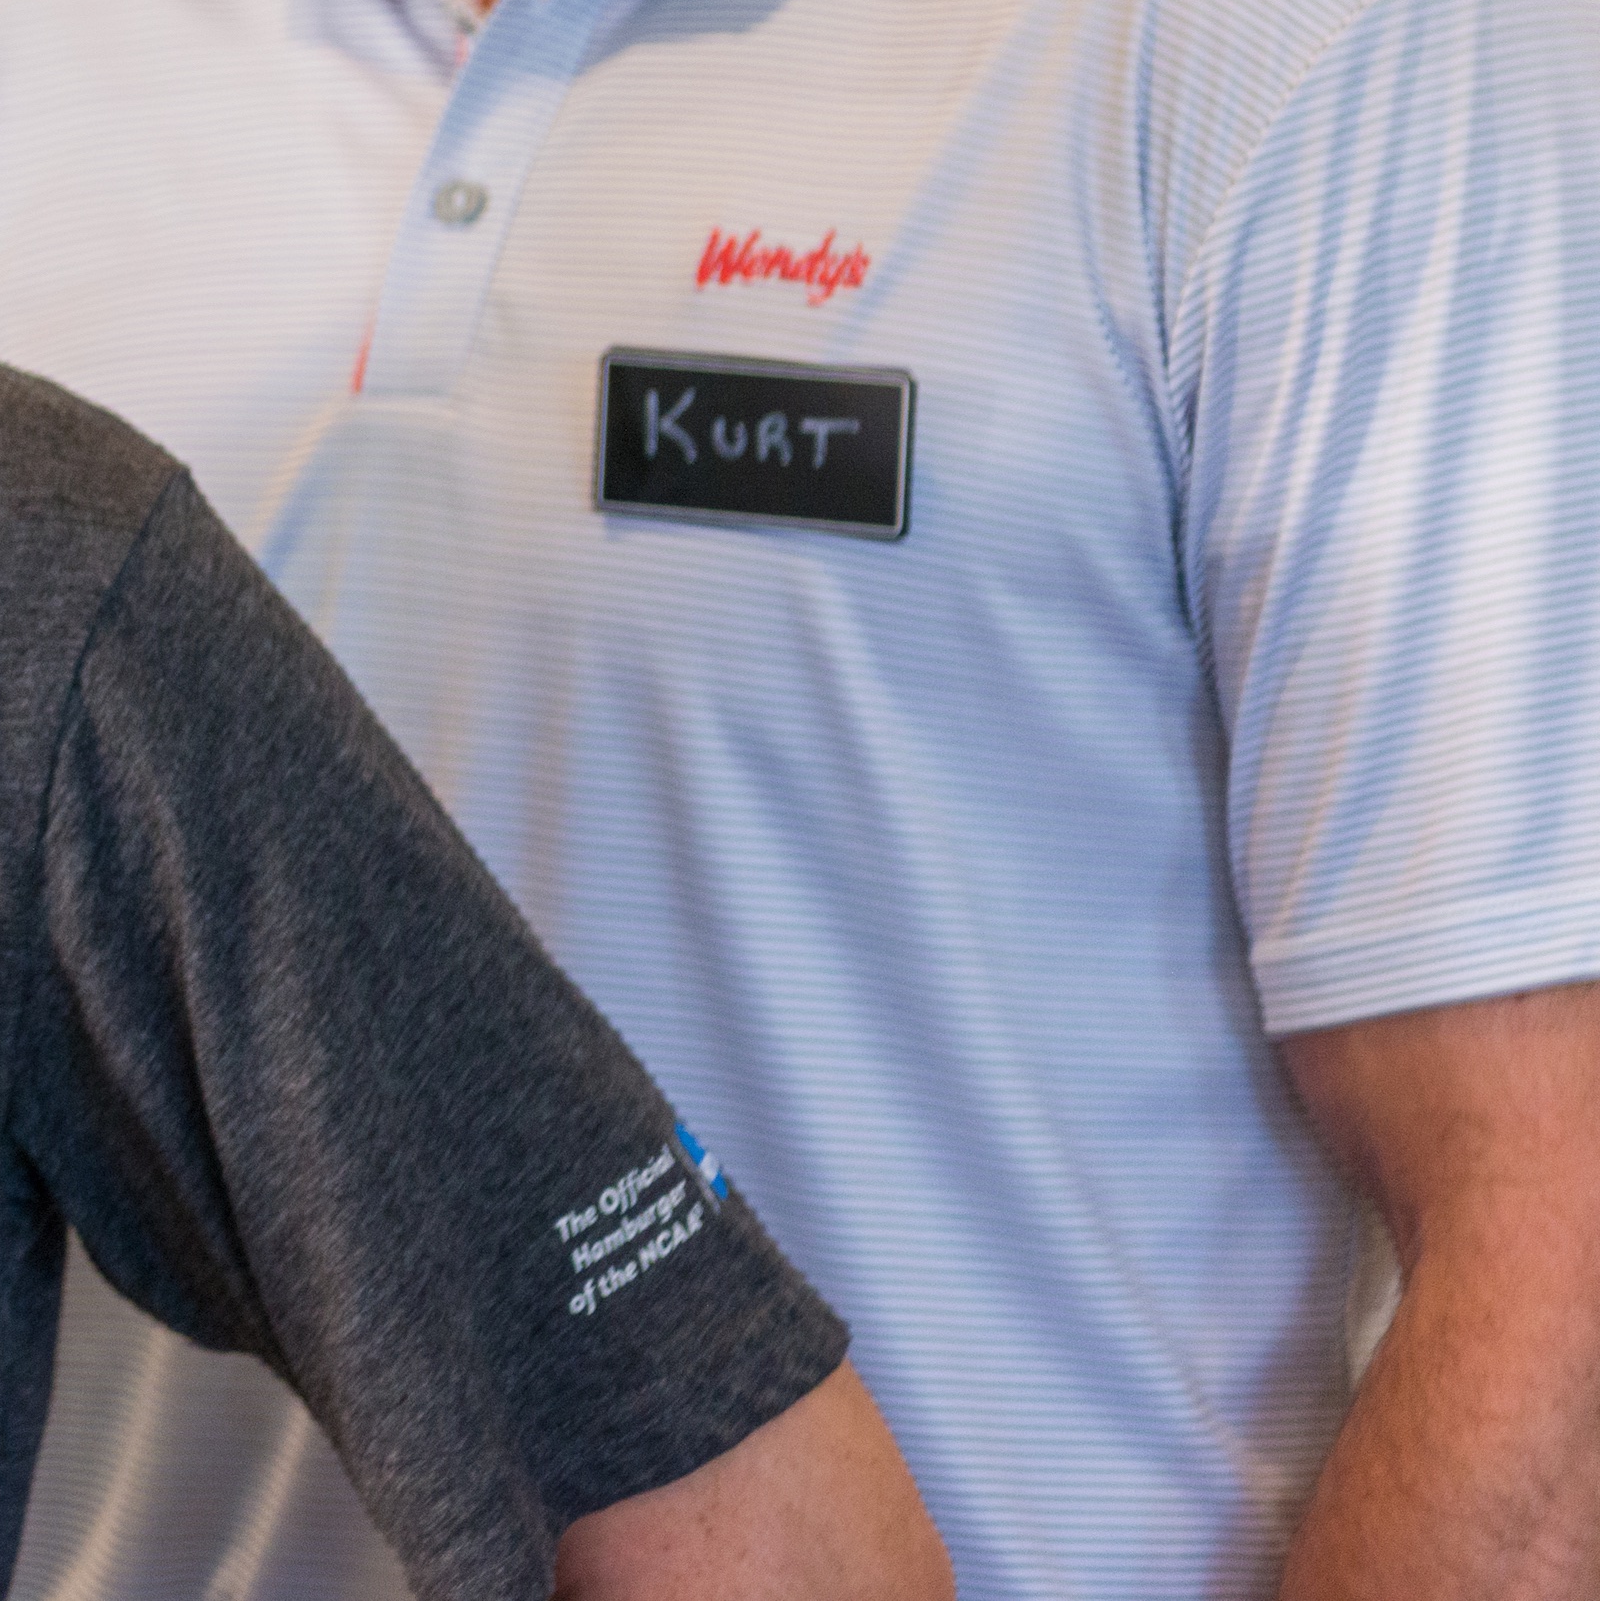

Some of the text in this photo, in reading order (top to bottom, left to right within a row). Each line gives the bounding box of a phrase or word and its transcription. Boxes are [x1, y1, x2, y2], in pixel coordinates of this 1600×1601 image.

[696, 226, 871, 307] Wendy's
[644, 387, 861, 470] KURT
[554, 1143, 675, 1243] The Official
[569, 1279, 596, 1316] of
[598, 1261, 638, 1298] the
